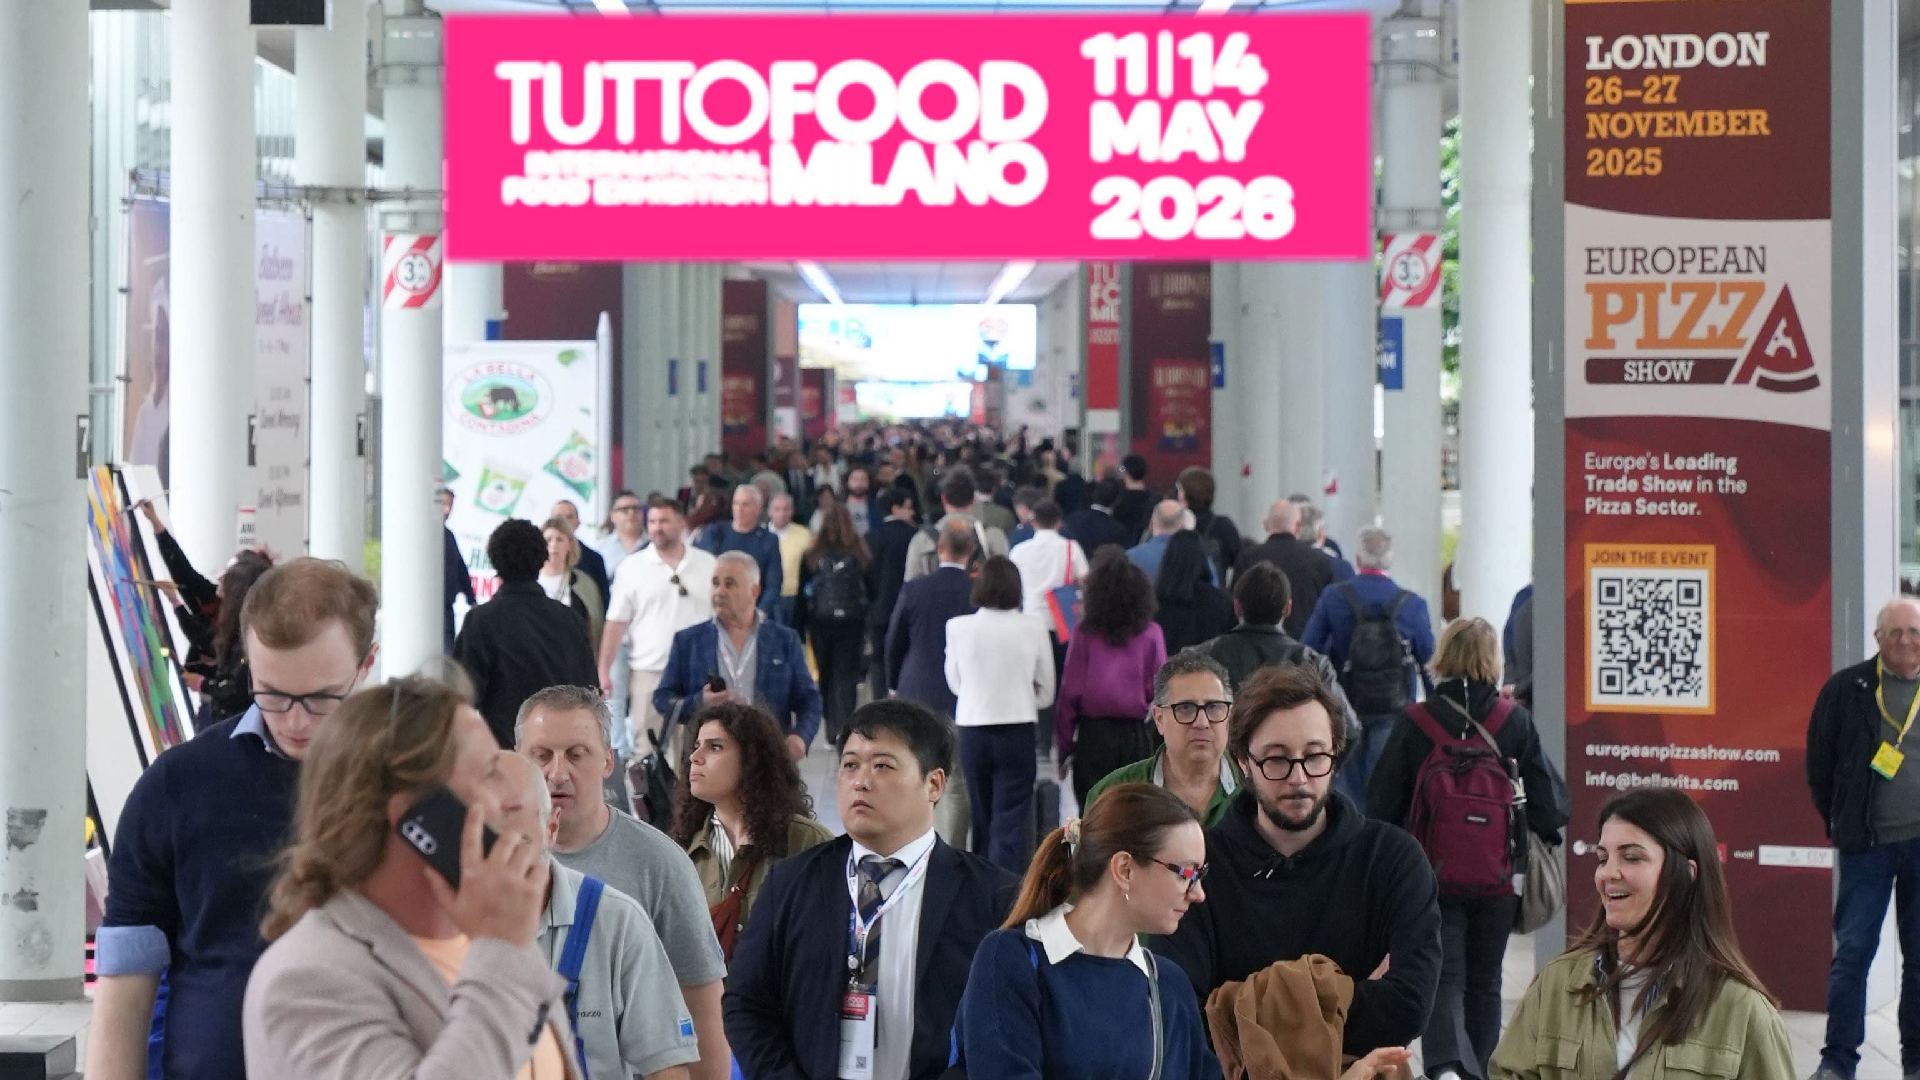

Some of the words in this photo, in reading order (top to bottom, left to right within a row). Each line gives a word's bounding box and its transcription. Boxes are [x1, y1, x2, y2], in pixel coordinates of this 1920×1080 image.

[1585, 32, 1770, 70] LONDON
[1089, 100, 1264, 162] MAY
[1586, 109, 1771, 139] NOVEMBER
[769, 141, 1049, 206] MILANO
[1586, 147, 1663, 177] 2025
[1090, 176, 1295, 240] 2026
[1585, 246, 1766, 275] EUROPEAN
[1624, 360, 1694, 382] SHOW
[1584, 452, 1660, 474] Europe's
[1663, 452, 1737, 476] Leading
[1584, 474, 1638, 492] Trade
[1642, 475, 1692, 493] Show
[1696, 475, 1714, 493] in
[1717, 476, 1747, 494] the
[1585, 497, 1632, 515] Pizza
[1635, 498, 1702, 515] Sector.
[1592, 551, 1626, 563] JOIN
[1631, 551, 1657, 564] THE
[1661, 552, 1708, 565] EVENT
[1585, 743, 1780, 763] europeanpizzashow.com
[1585, 770, 1739, 791] info@bellavita.com
